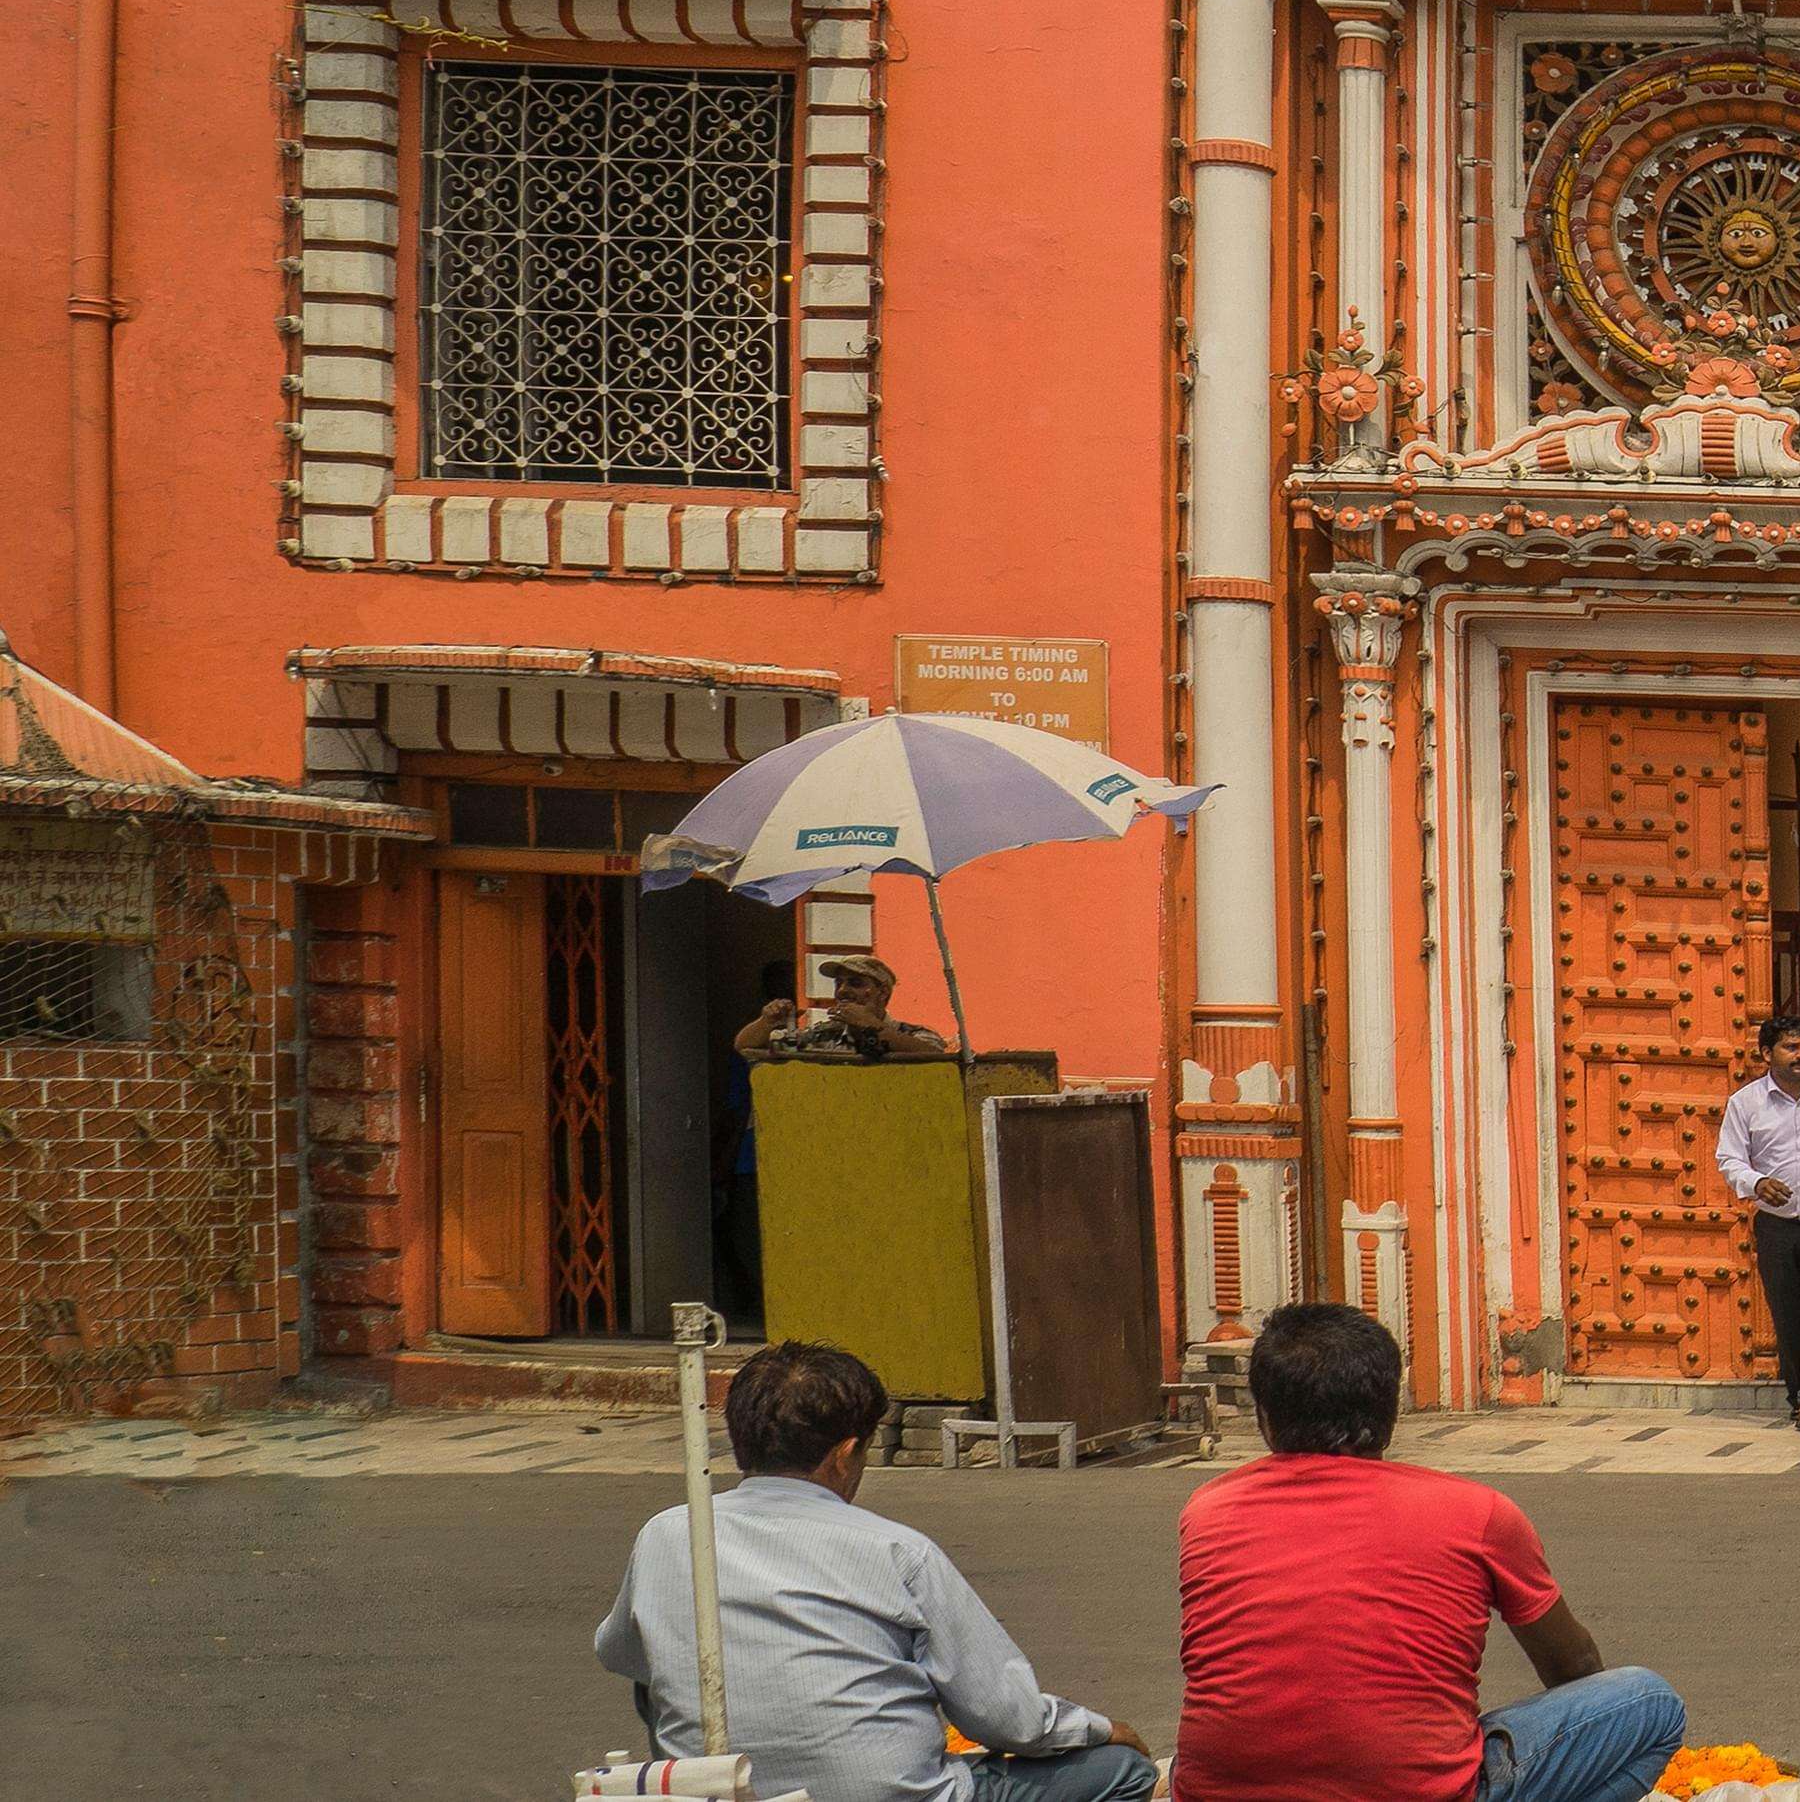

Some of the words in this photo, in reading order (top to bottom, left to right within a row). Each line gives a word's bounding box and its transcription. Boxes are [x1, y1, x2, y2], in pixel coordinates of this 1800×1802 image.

[928, 644, 1004, 661] TEMPLE
[1009, 647, 1078, 663] TIMING
[918, 664, 1009, 681] MORNING
[1015, 667, 1054, 682] 6:00
[1059, 668, 1089, 683] AM
[990, 692, 1016, 707] TO
[1042, 713, 1070, 728] PM
